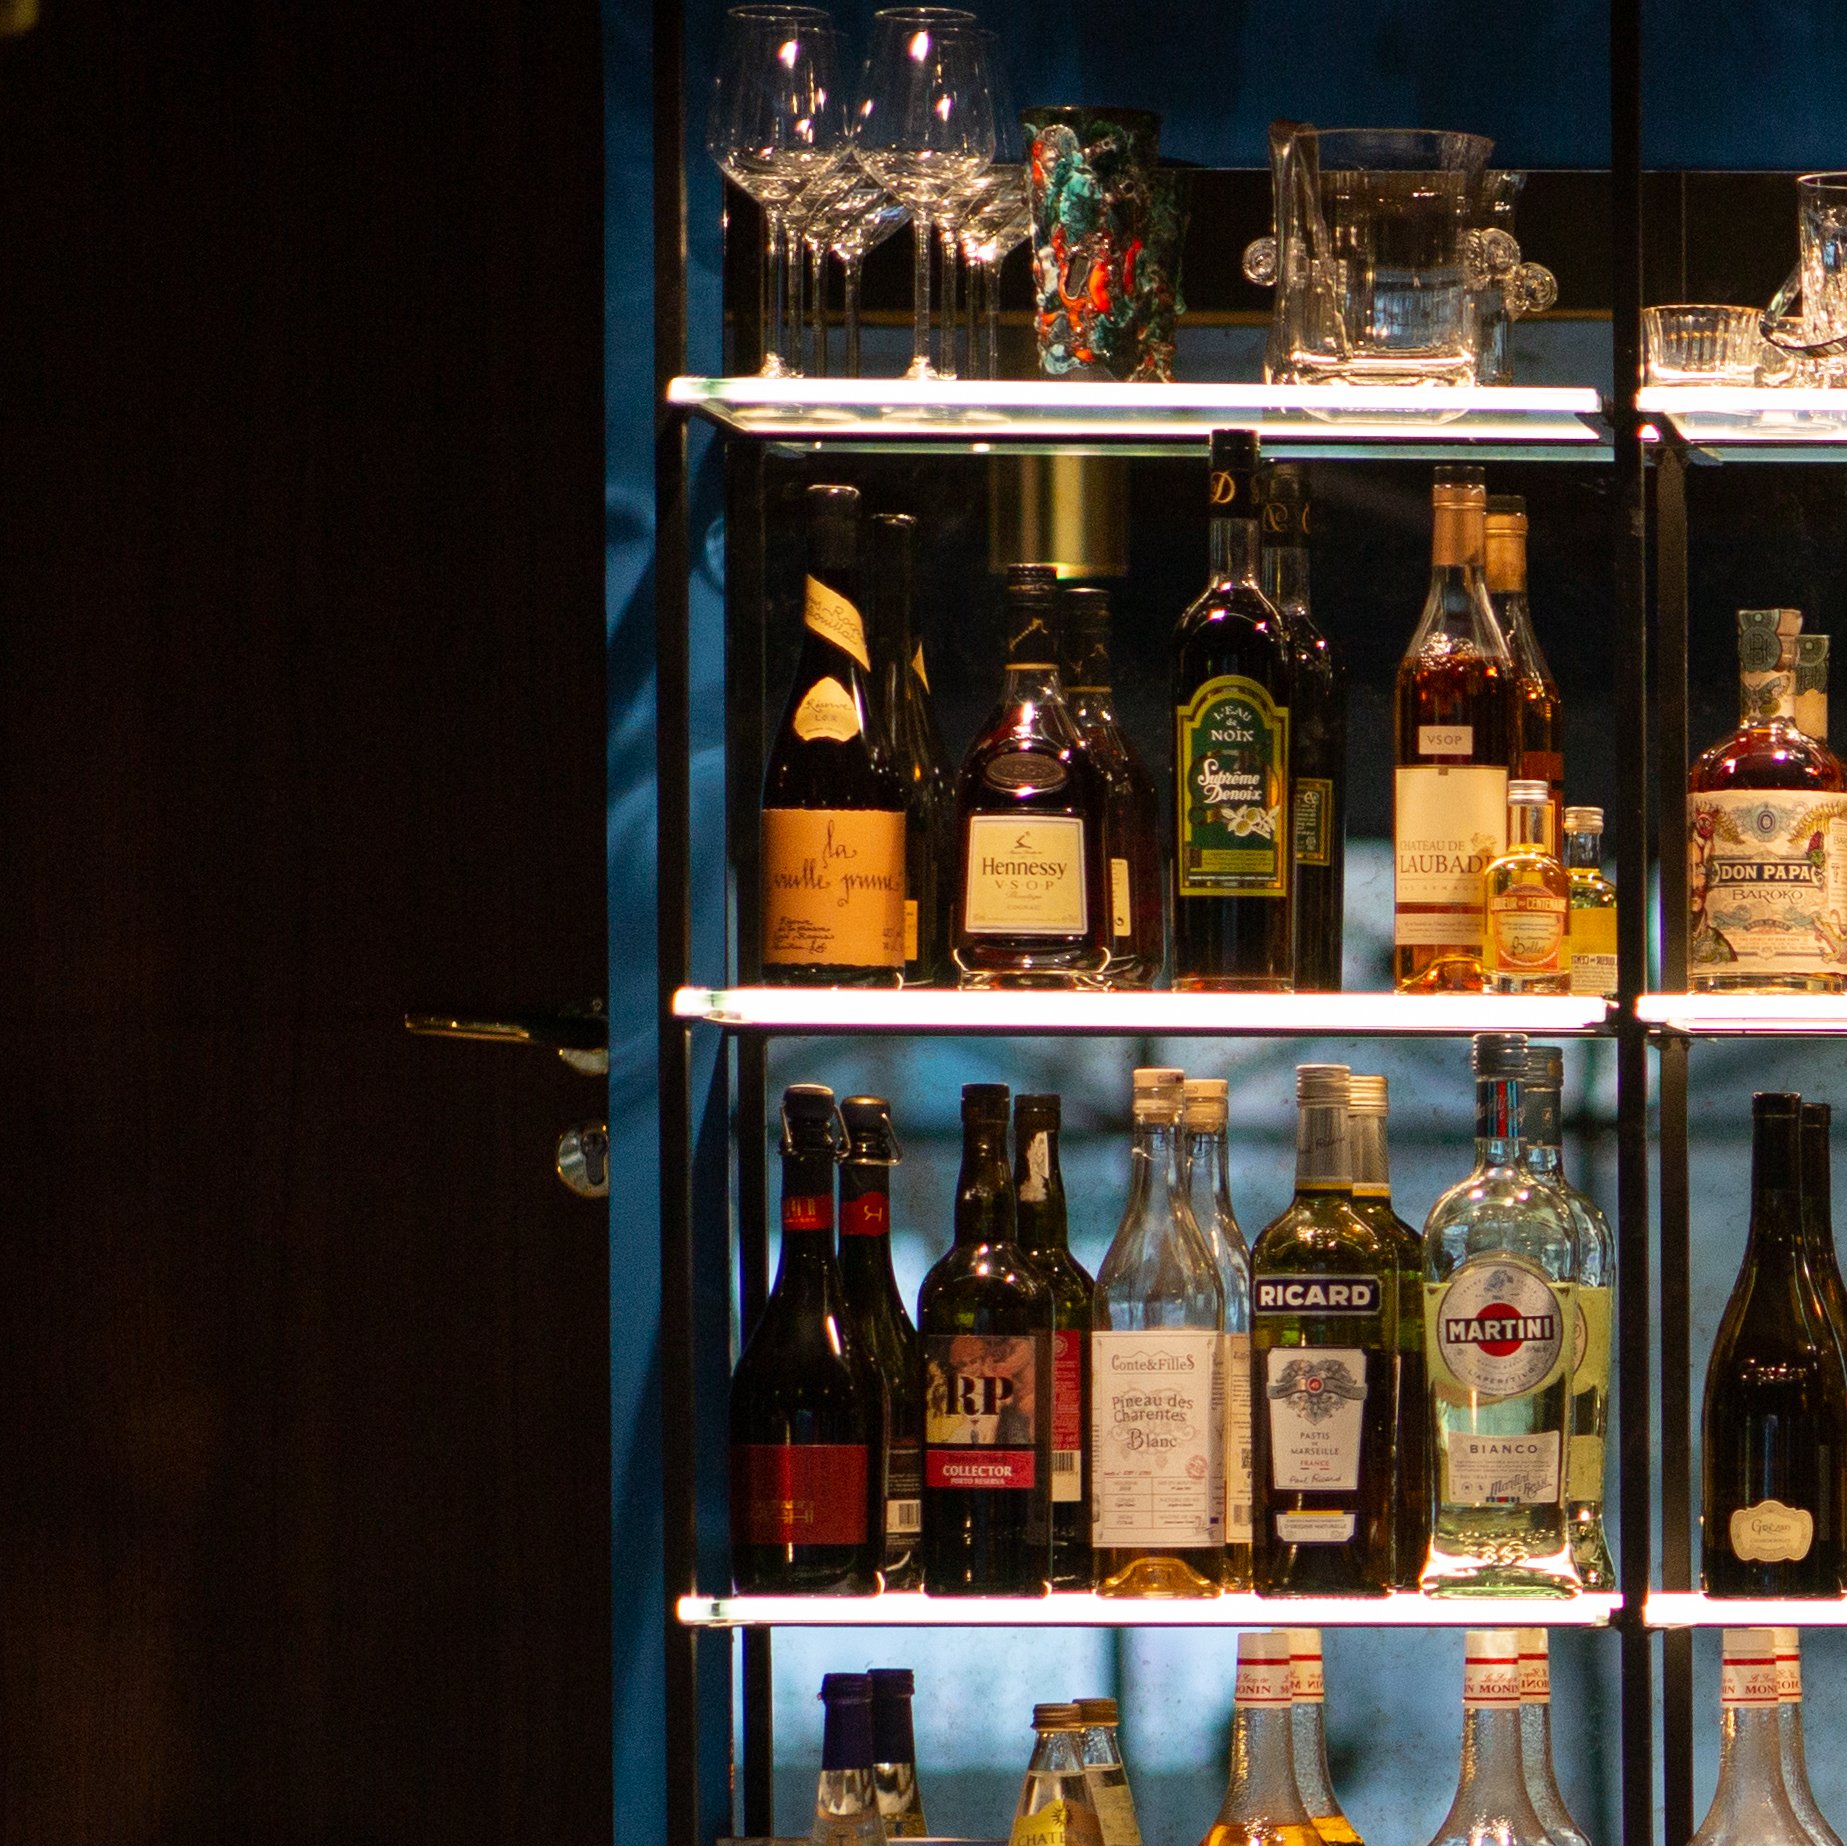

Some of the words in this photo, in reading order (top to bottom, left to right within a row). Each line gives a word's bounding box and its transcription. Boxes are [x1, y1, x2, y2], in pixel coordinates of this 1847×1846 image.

[1213, 705, 1253, 723] L'EAU
[1426, 733, 1464, 747] VSOP
[1203, 784, 1263, 804] Denoix
[1451, 840, 1466, 851] DE
[981, 857, 1067, 880] Hennessy
[1720, 864, 1758, 881] DON
[1763, 864, 1811, 881] PAPA
[1732, 889, 1804, 904] BAROKO
[1259, 1285, 1372, 1307] RICARD
[1449, 1316, 1551, 1342] MARTINI
[944, 1376, 1014, 1416] RP
[1113, 1395, 1163, 1410] Pineau
[1167, 1394, 1195, 1410] des
[1113, 1408, 1187, 1424] Charentes
[1126, 1427, 1178, 1451] Blanc
[1300, 1431, 1331, 1441] PASTIS
[1290, 1447, 1340, 1456] MARSEILLE
[1469, 1443, 1539, 1455] BIANCO
[942, 1465, 1013, 1477] COLLECTOR
